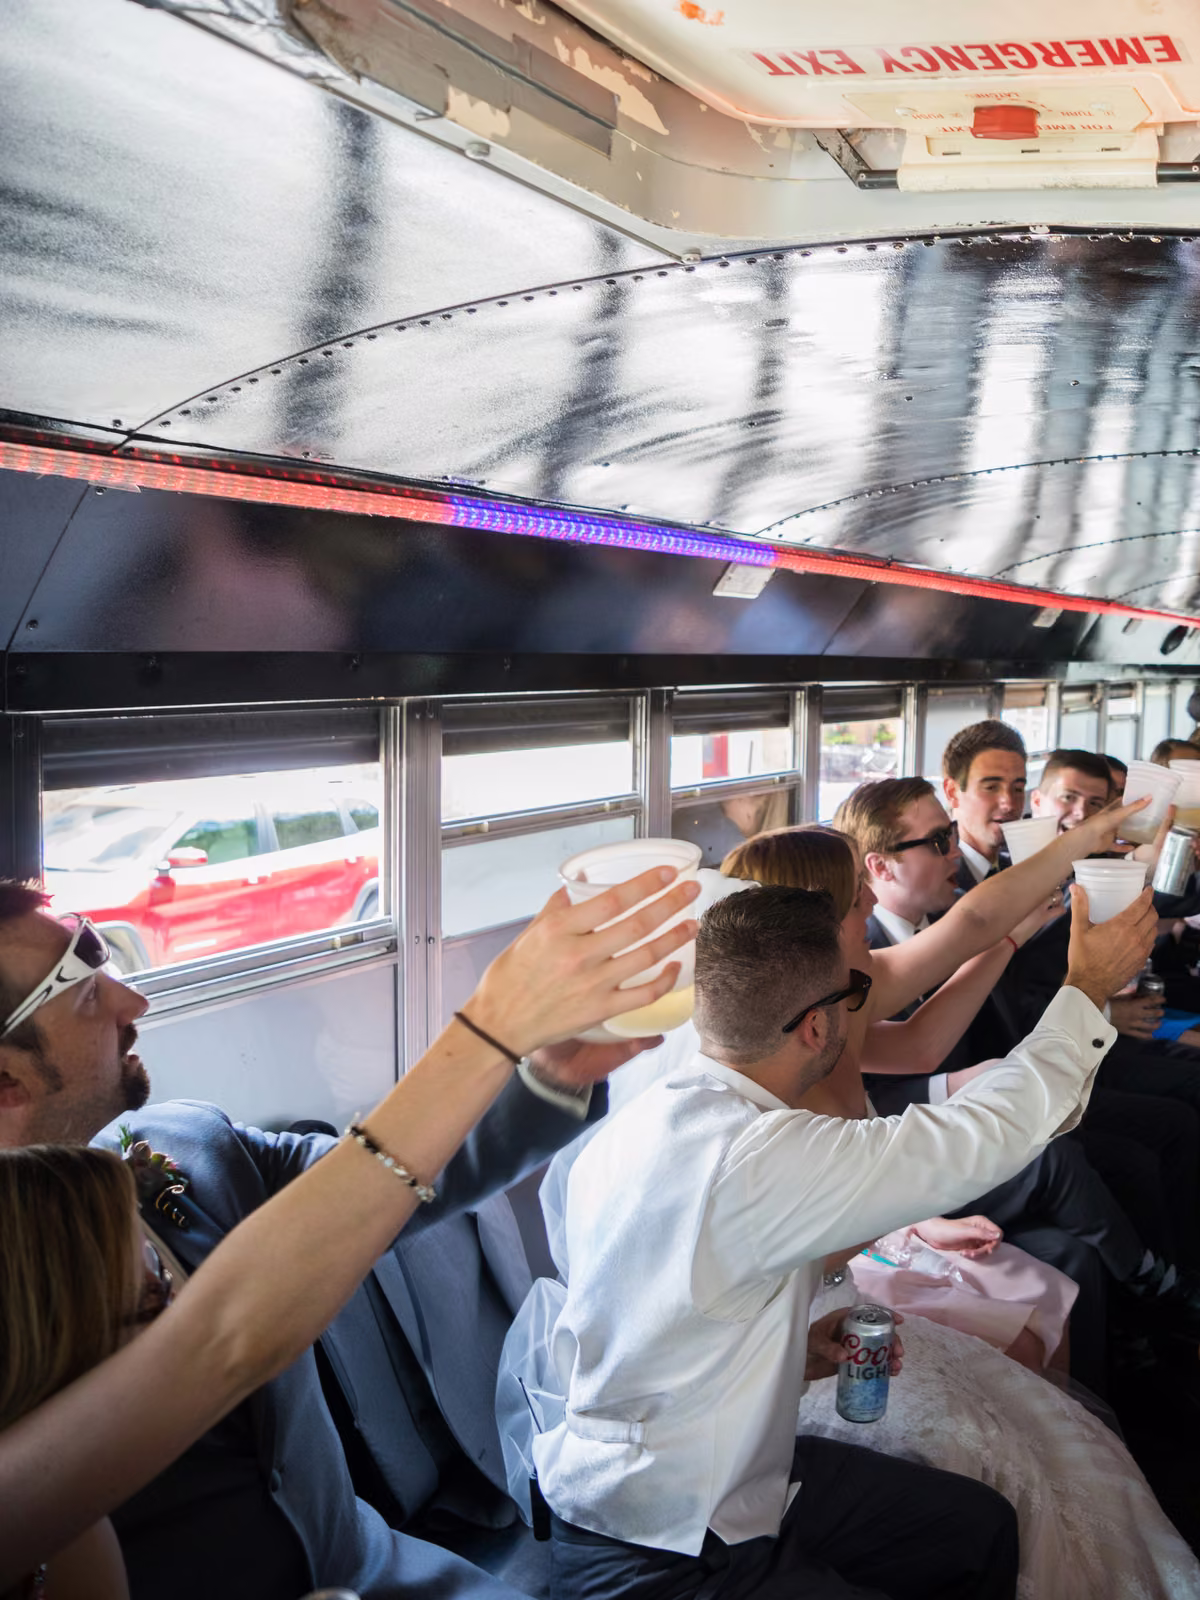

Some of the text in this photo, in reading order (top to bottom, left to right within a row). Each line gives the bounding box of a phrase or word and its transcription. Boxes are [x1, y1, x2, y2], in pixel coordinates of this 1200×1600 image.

[752, 34, 1183, 76] EMERGENCY EXIT
[847, 1363, 887, 1381] LIGH
